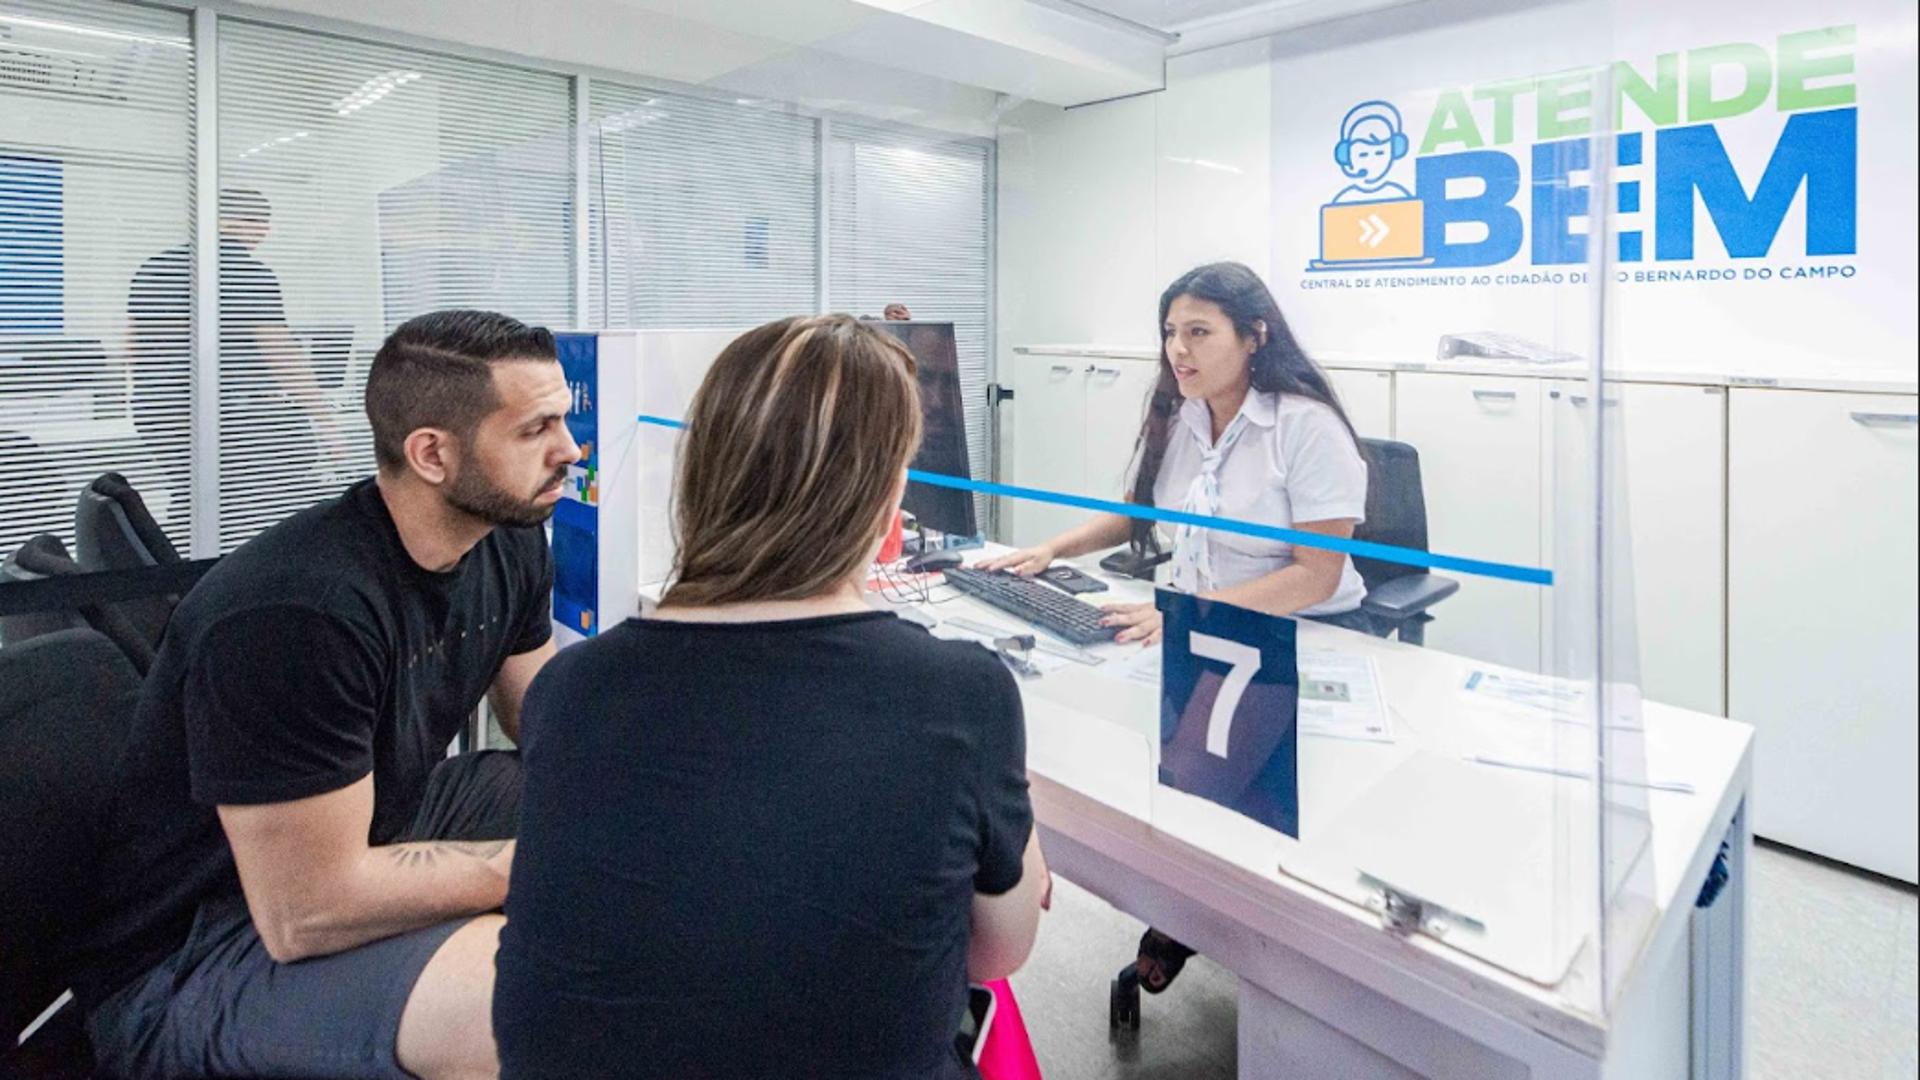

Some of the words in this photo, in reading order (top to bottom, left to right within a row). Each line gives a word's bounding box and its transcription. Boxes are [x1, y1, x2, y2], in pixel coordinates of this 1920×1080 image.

[1418, 24, 1857, 155] ATENDE
[1415, 106, 1858, 270] BEM
[1300, 278, 1352, 290] CENTRAL
[1356, 278, 1371, 289] DE
[1375, 275, 1467, 288] ATENDIMENTO
[1471, 275, 1492, 287] AO
[1496, 271, 1565, 286] CIDADÃO
[1634, 268, 1737, 283] BERNARDO
[1743, 267, 1773, 281] DO
[1779, 265, 1857, 280] CAMPO
[1189, 629, 1262, 760] 7
